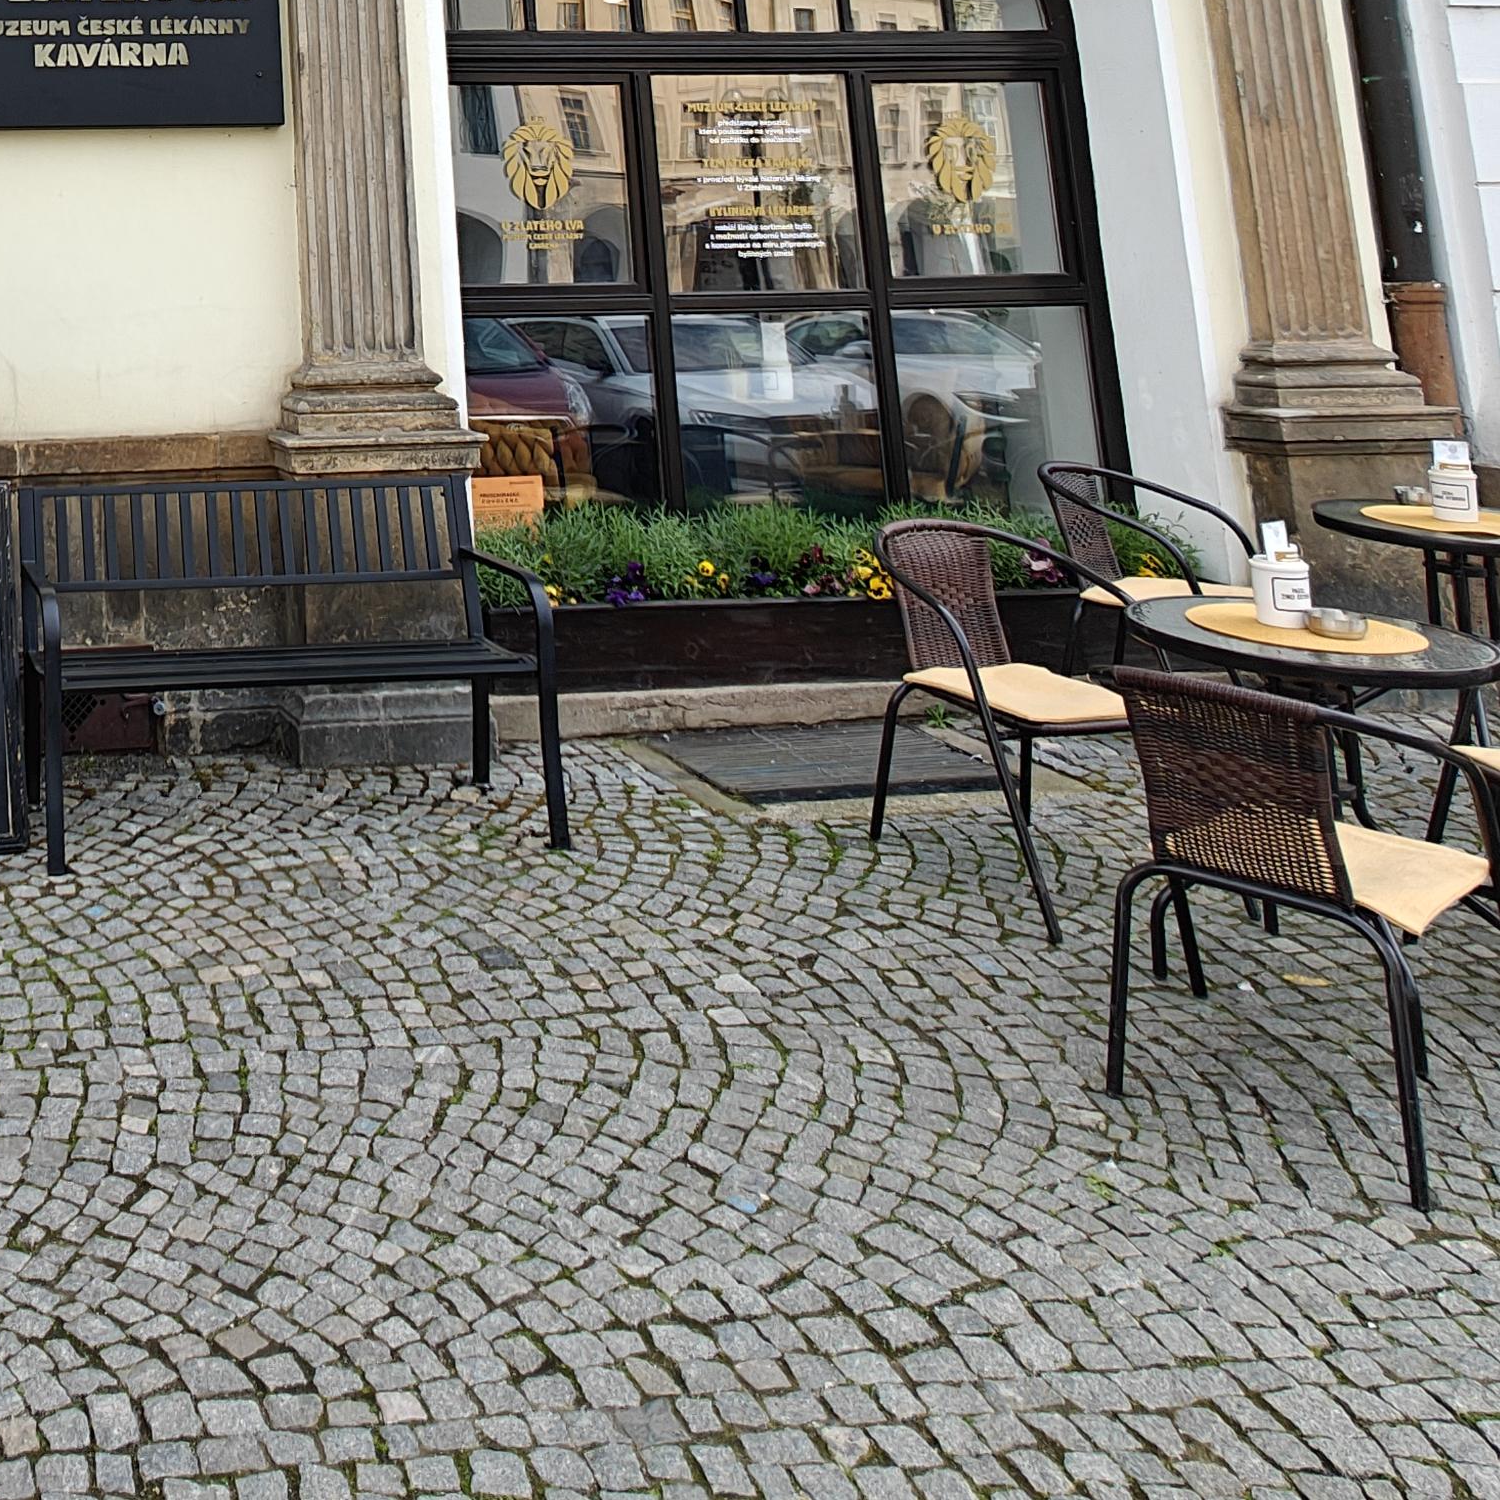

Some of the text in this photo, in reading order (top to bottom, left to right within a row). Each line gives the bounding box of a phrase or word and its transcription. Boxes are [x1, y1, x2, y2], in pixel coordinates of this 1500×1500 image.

[77, 15, 144, 36] ČESKÉ
[150, 15, 250, 35] LÉKÁRNY
[33, 38, 189, 67] KAVÁRNA
